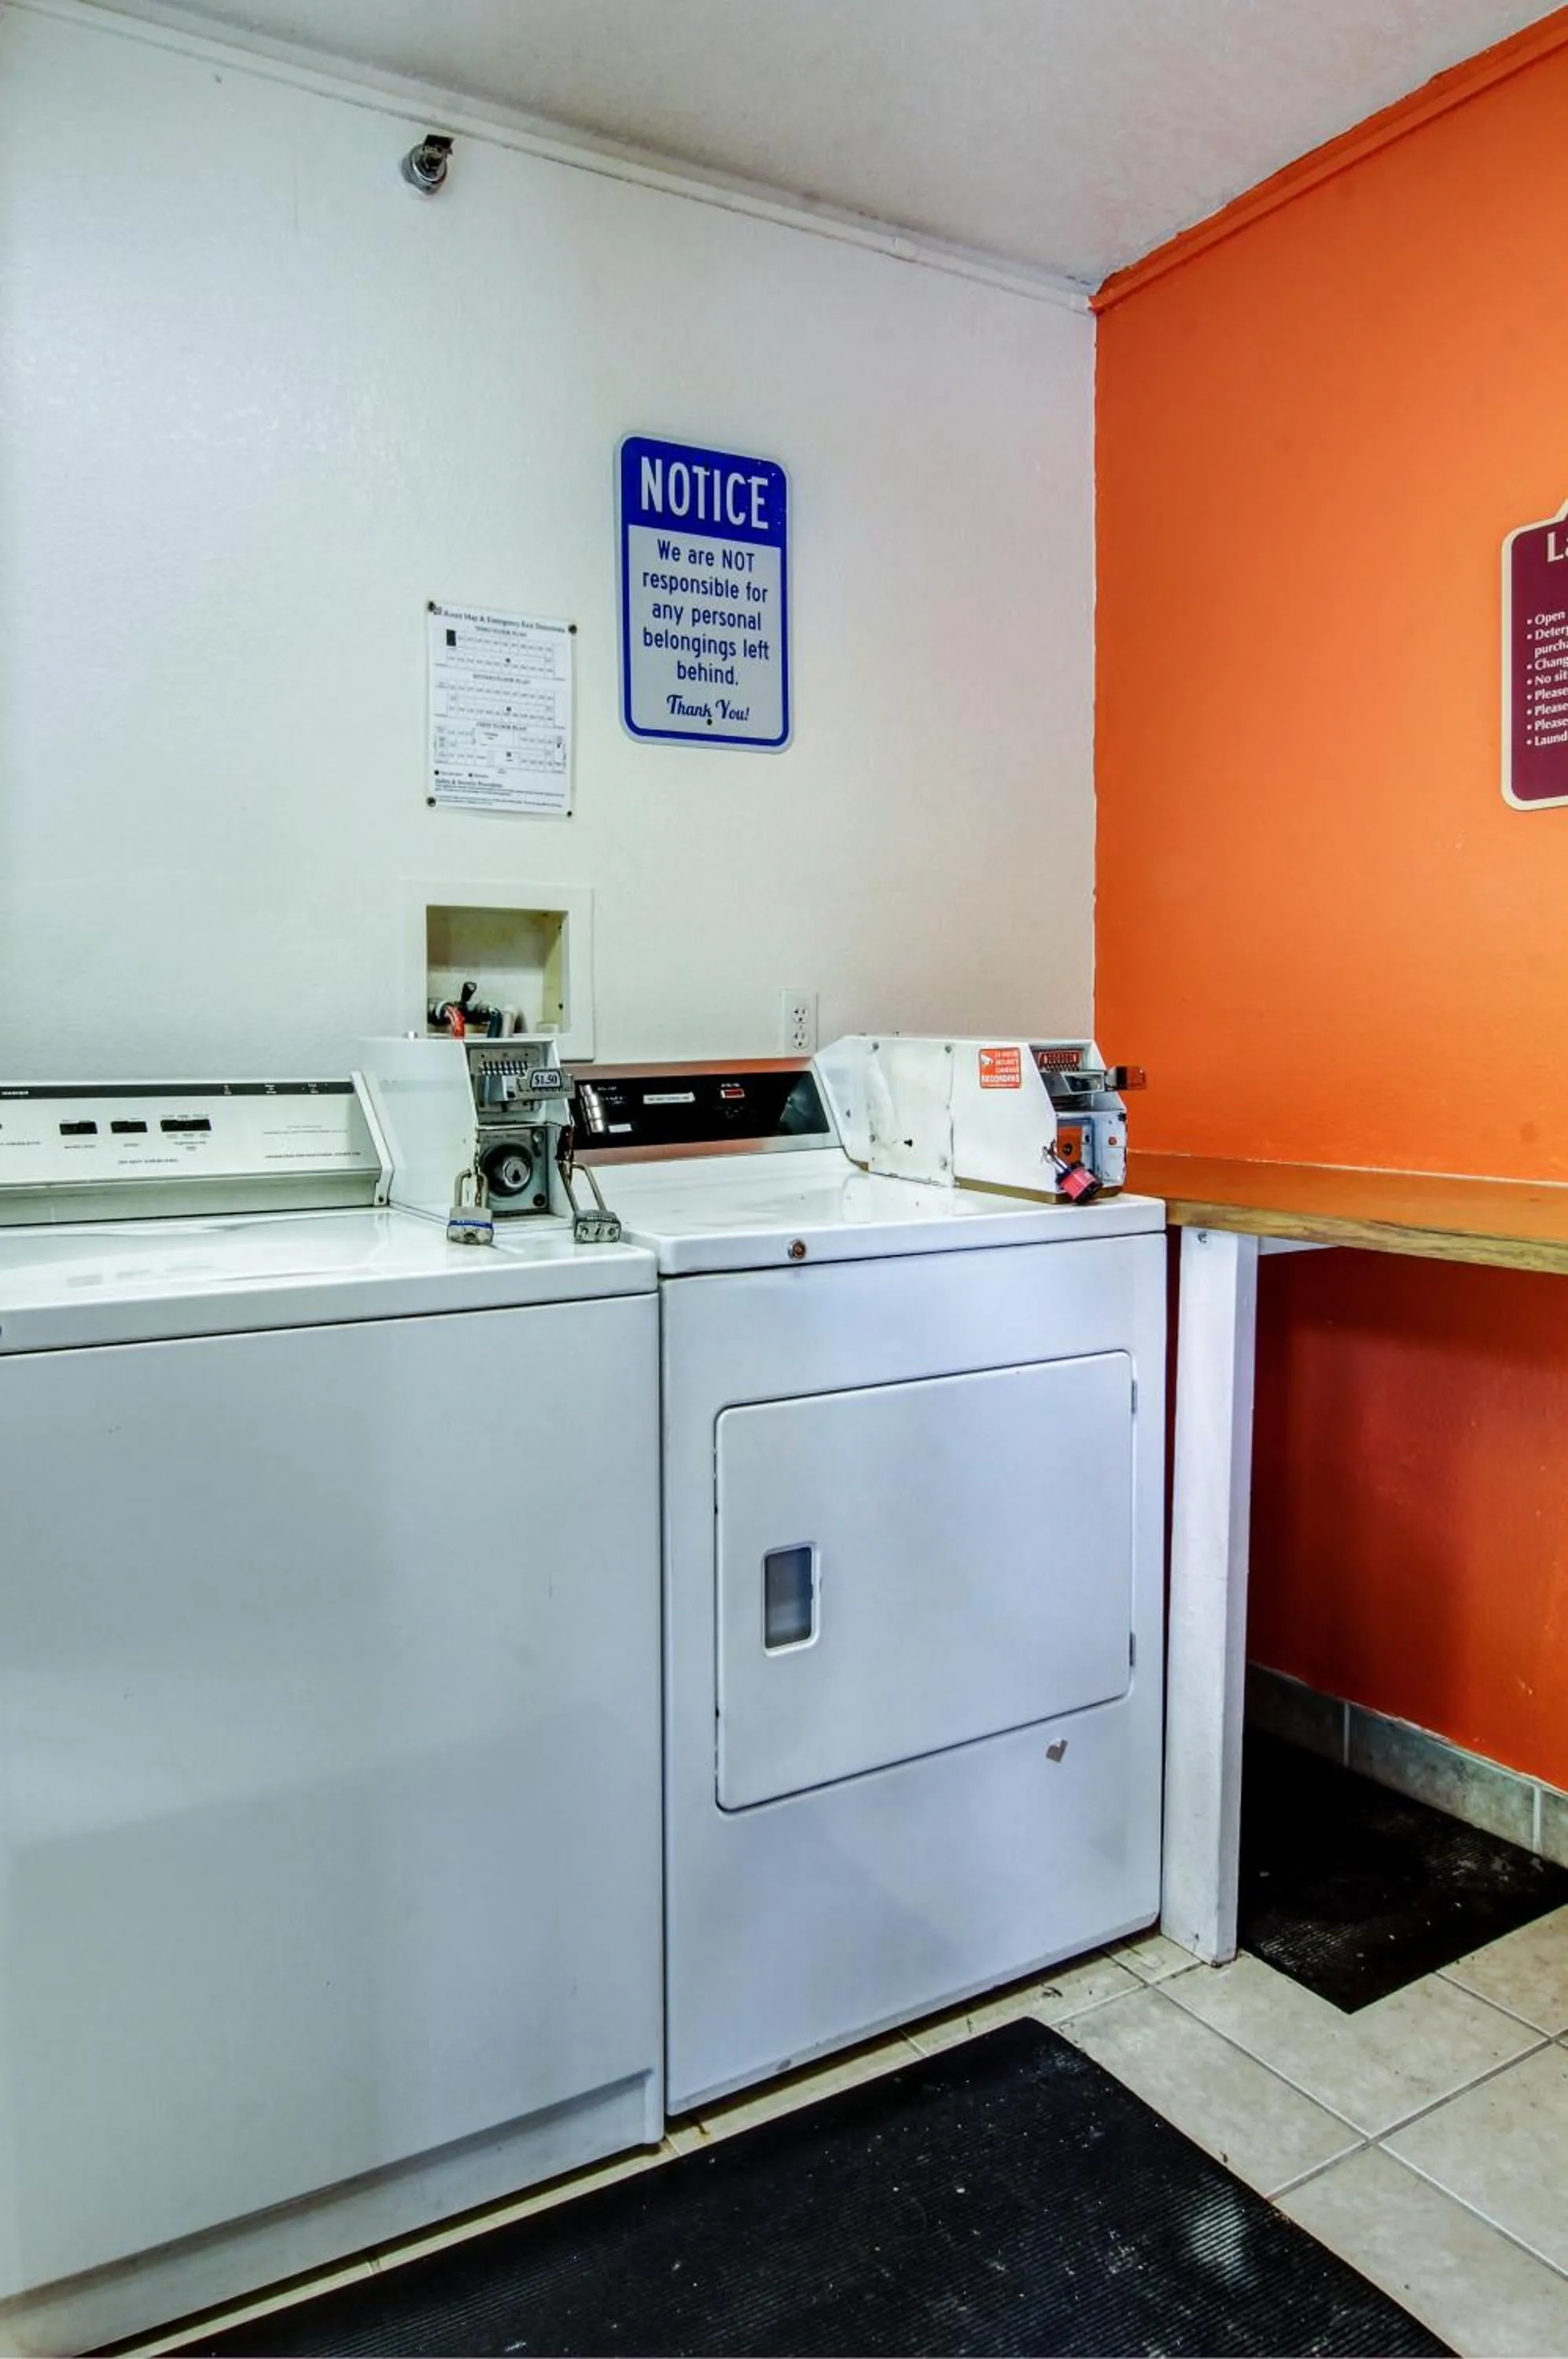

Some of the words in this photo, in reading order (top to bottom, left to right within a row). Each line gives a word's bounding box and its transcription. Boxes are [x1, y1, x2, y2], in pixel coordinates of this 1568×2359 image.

[641, 455, 768, 529] NOTICE
[657, 539, 681, 561] We
[688, 549, 714, 567] are
[723, 549, 754, 572] NOT
[642, 572, 739, 599] responsible
[746, 582, 767, 603] for
[652, 603, 683, 626] any
[691, 608, 761, 631] personal
[1535, 611, 1566, 627] Open
[643, 627, 736, 662] belongings
[743, 639, 769, 660] left
[677, 661, 738, 686] behind.
[1535, 675, 1549, 686] No
[666, 694, 712, 719] Thank
[715, 699, 750, 721] You!
[534, 1073, 558, 1085] $1.50
